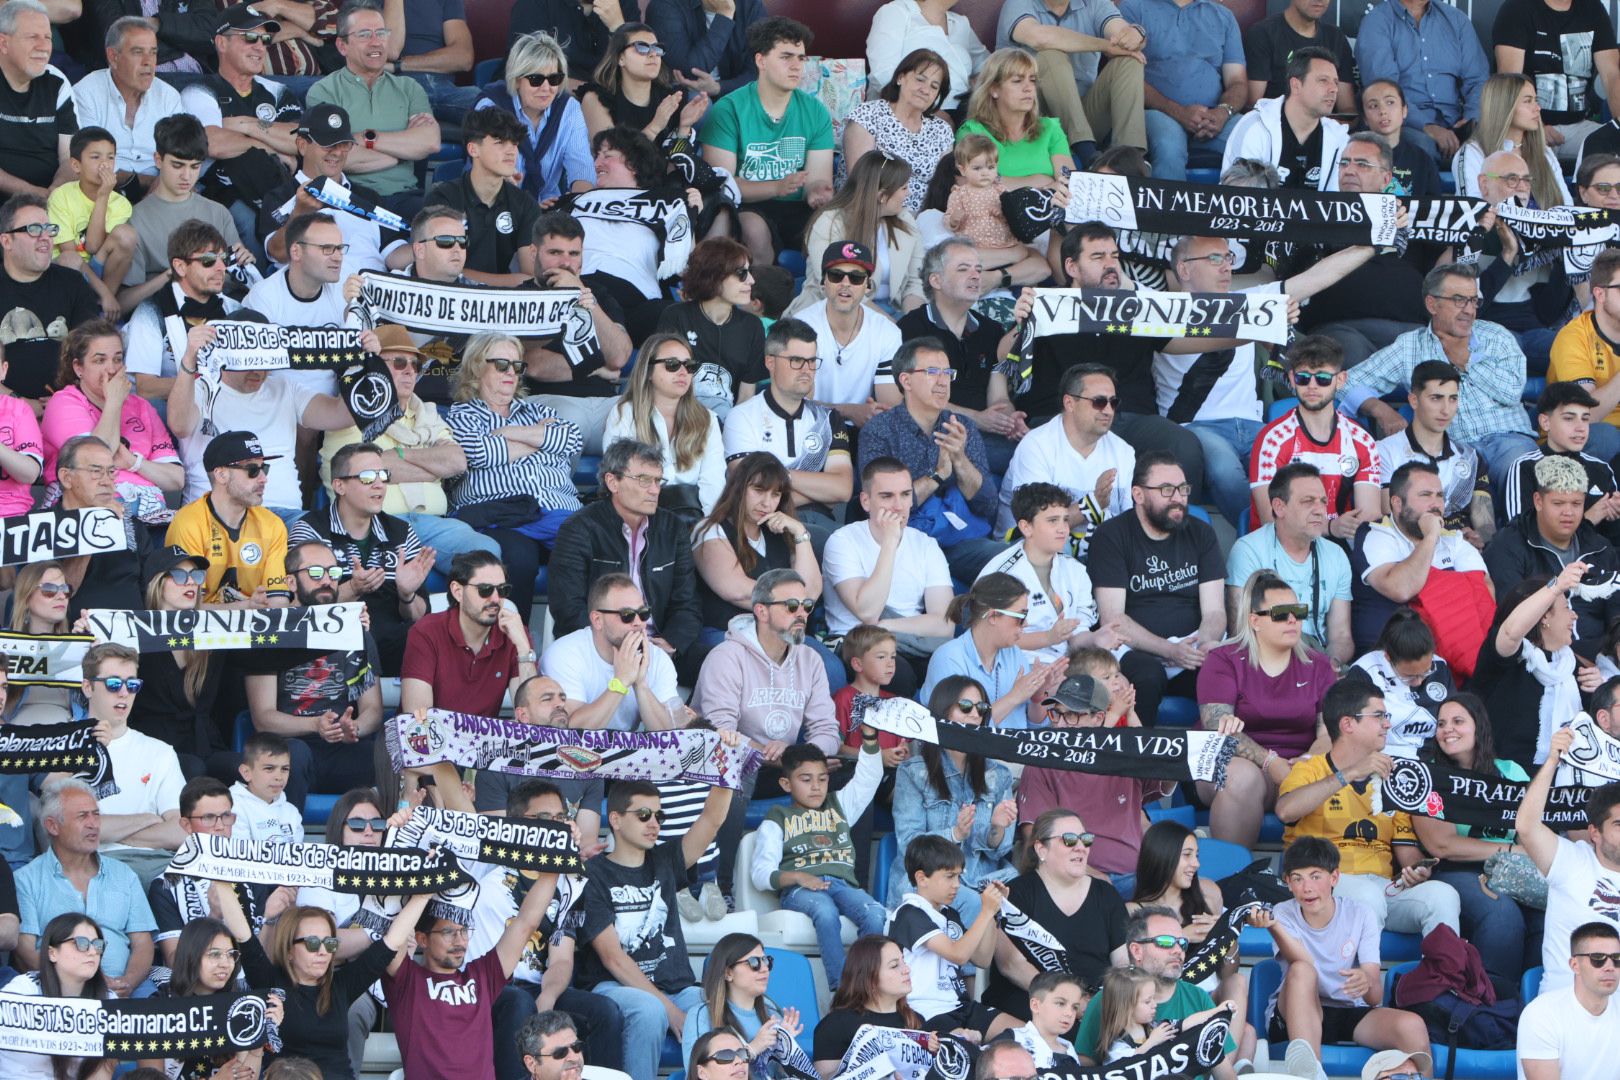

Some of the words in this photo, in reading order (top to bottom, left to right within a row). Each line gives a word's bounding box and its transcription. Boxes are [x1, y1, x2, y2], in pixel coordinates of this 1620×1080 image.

[1209, 215, 1239, 230] 1923
[1253, 219, 1285, 232] 2013
[1315, 200, 1364, 223] VDS
[438, 297, 456, 320] DE
[461, 299, 544, 325] SALAMANCA
[259, 325, 279, 349] de
[1146, 555, 1170, 574] La
[1130, 562, 1199, 592] Chupitería
[0, 731, 67, 752] alamanca
[584, 730, 680, 750] SALAMANCA
[1135, 735, 1185, 757] VDS
[1016, 741, 1048, 759] 1923
[1064, 748, 1096, 765] 2013
[455, 813, 477, 838] de
[478, 815, 569, 851] Salamanca
[211, 834, 303, 867] UNIONISTAS
[305, 844, 327, 868] de
[327, 845, 421, 872] Salamanca
[426, 976, 478, 1006] VANS
[76, 1008, 97, 1034] de
[97, 1008, 187, 1035] Salamanca
[901, 1042, 911, 1064] FC
